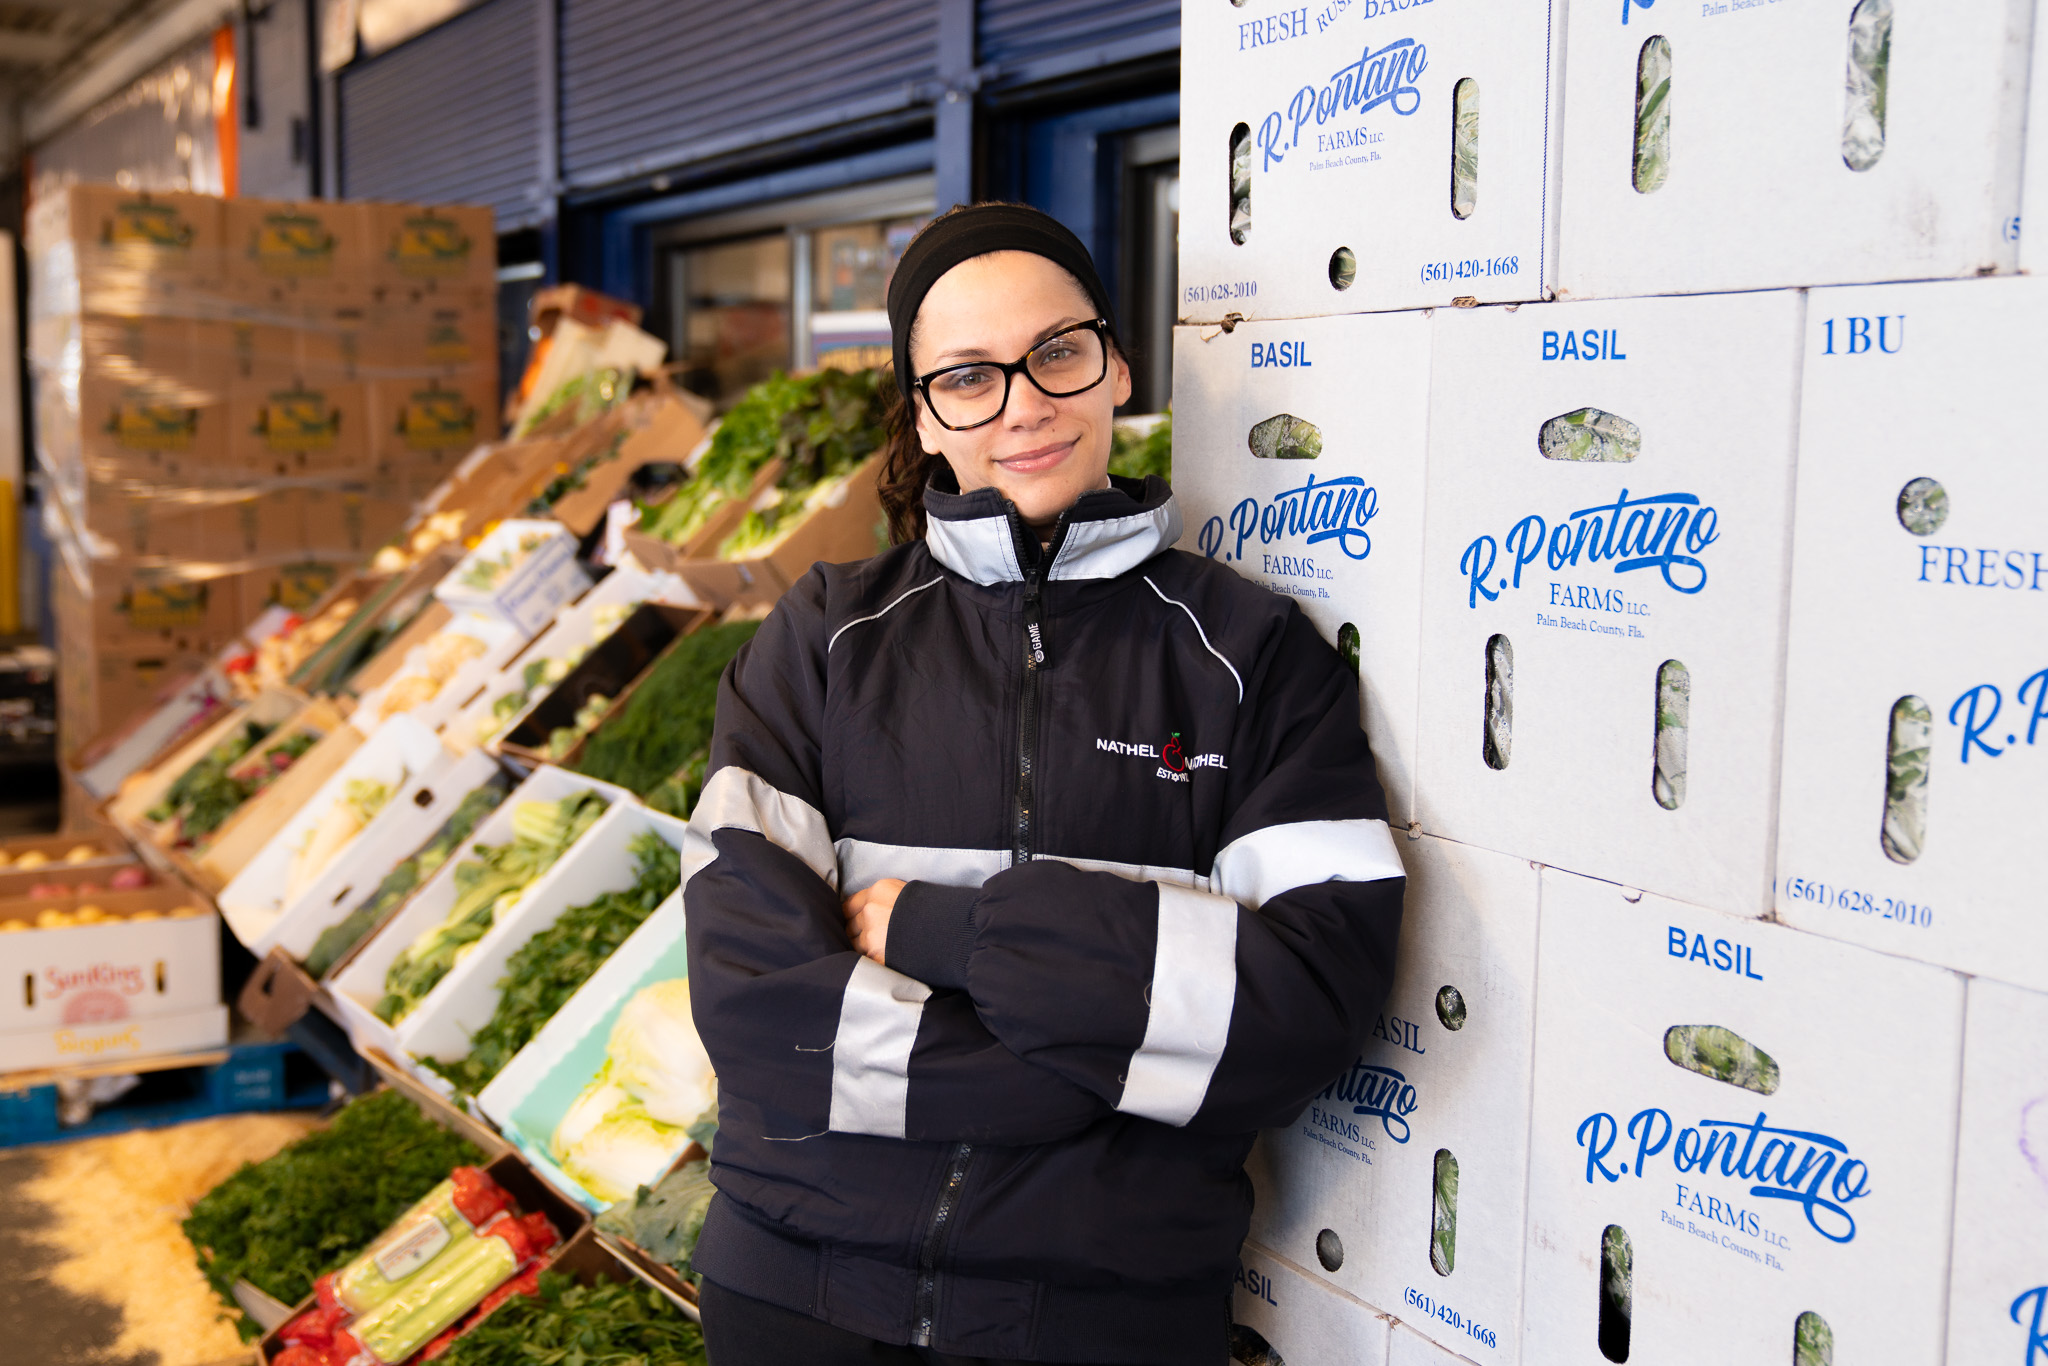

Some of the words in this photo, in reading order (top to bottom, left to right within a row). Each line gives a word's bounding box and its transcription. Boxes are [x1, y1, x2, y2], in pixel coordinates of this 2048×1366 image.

[1316, 0, 1352, 33] RUS
[1702, 2, 1728, 17] Palm
[1239, 8, 1308, 51] FRESH
[1318, 127, 1367, 152] FARMS
[1309, 161, 1324, 171] Palm
[1325, 157, 1343, 168] Beach
[1251, 342, 1312, 368] BASIL
[1542, 329, 1626, 361] BASIL
[1460, 488, 1720, 609] R.Pontano
[1263, 554, 1314, 578] FARMS
[1918, 545, 2048, 591] FRESH
[1272, 583, 1291, 594] Beach
[1292, 585, 1316, 598] County,
[1549, 583, 1623, 613] FARMS
[1028, 622, 1042, 650] GAME
[1537, 613, 1558, 627] Palm
[1560, 616, 1587, 631] Beach
[1589, 620, 1625, 638] County,
[1628, 625, 1645, 638] Fla.
[1097, 738, 1159, 758] NATHEL
[1668, 926, 1763, 981] BASIL
[1373, 1012, 1425, 1054] ASIL
[1312, 1107, 1360, 1142] FARMS
[1303, 1126, 1317, 1140] Palm
[1319, 1133, 1337, 1149] Beach
[1338, 1142, 1361, 1161] County,
[1362, 1152, 1373, 1165] Fla.
[1576, 1108, 1871, 1243] R.Pontano
[1676, 1183, 1760, 1237] FARMS
[1661, 1210, 1685, 1230] Palm
[1688, 1221, 1718, 1244] Beach
[1721, 1235, 1761, 1263] County,
[1765, 1253, 1784, 1271] Fla.
[1233, 1265, 1277, 1307] ASIL
